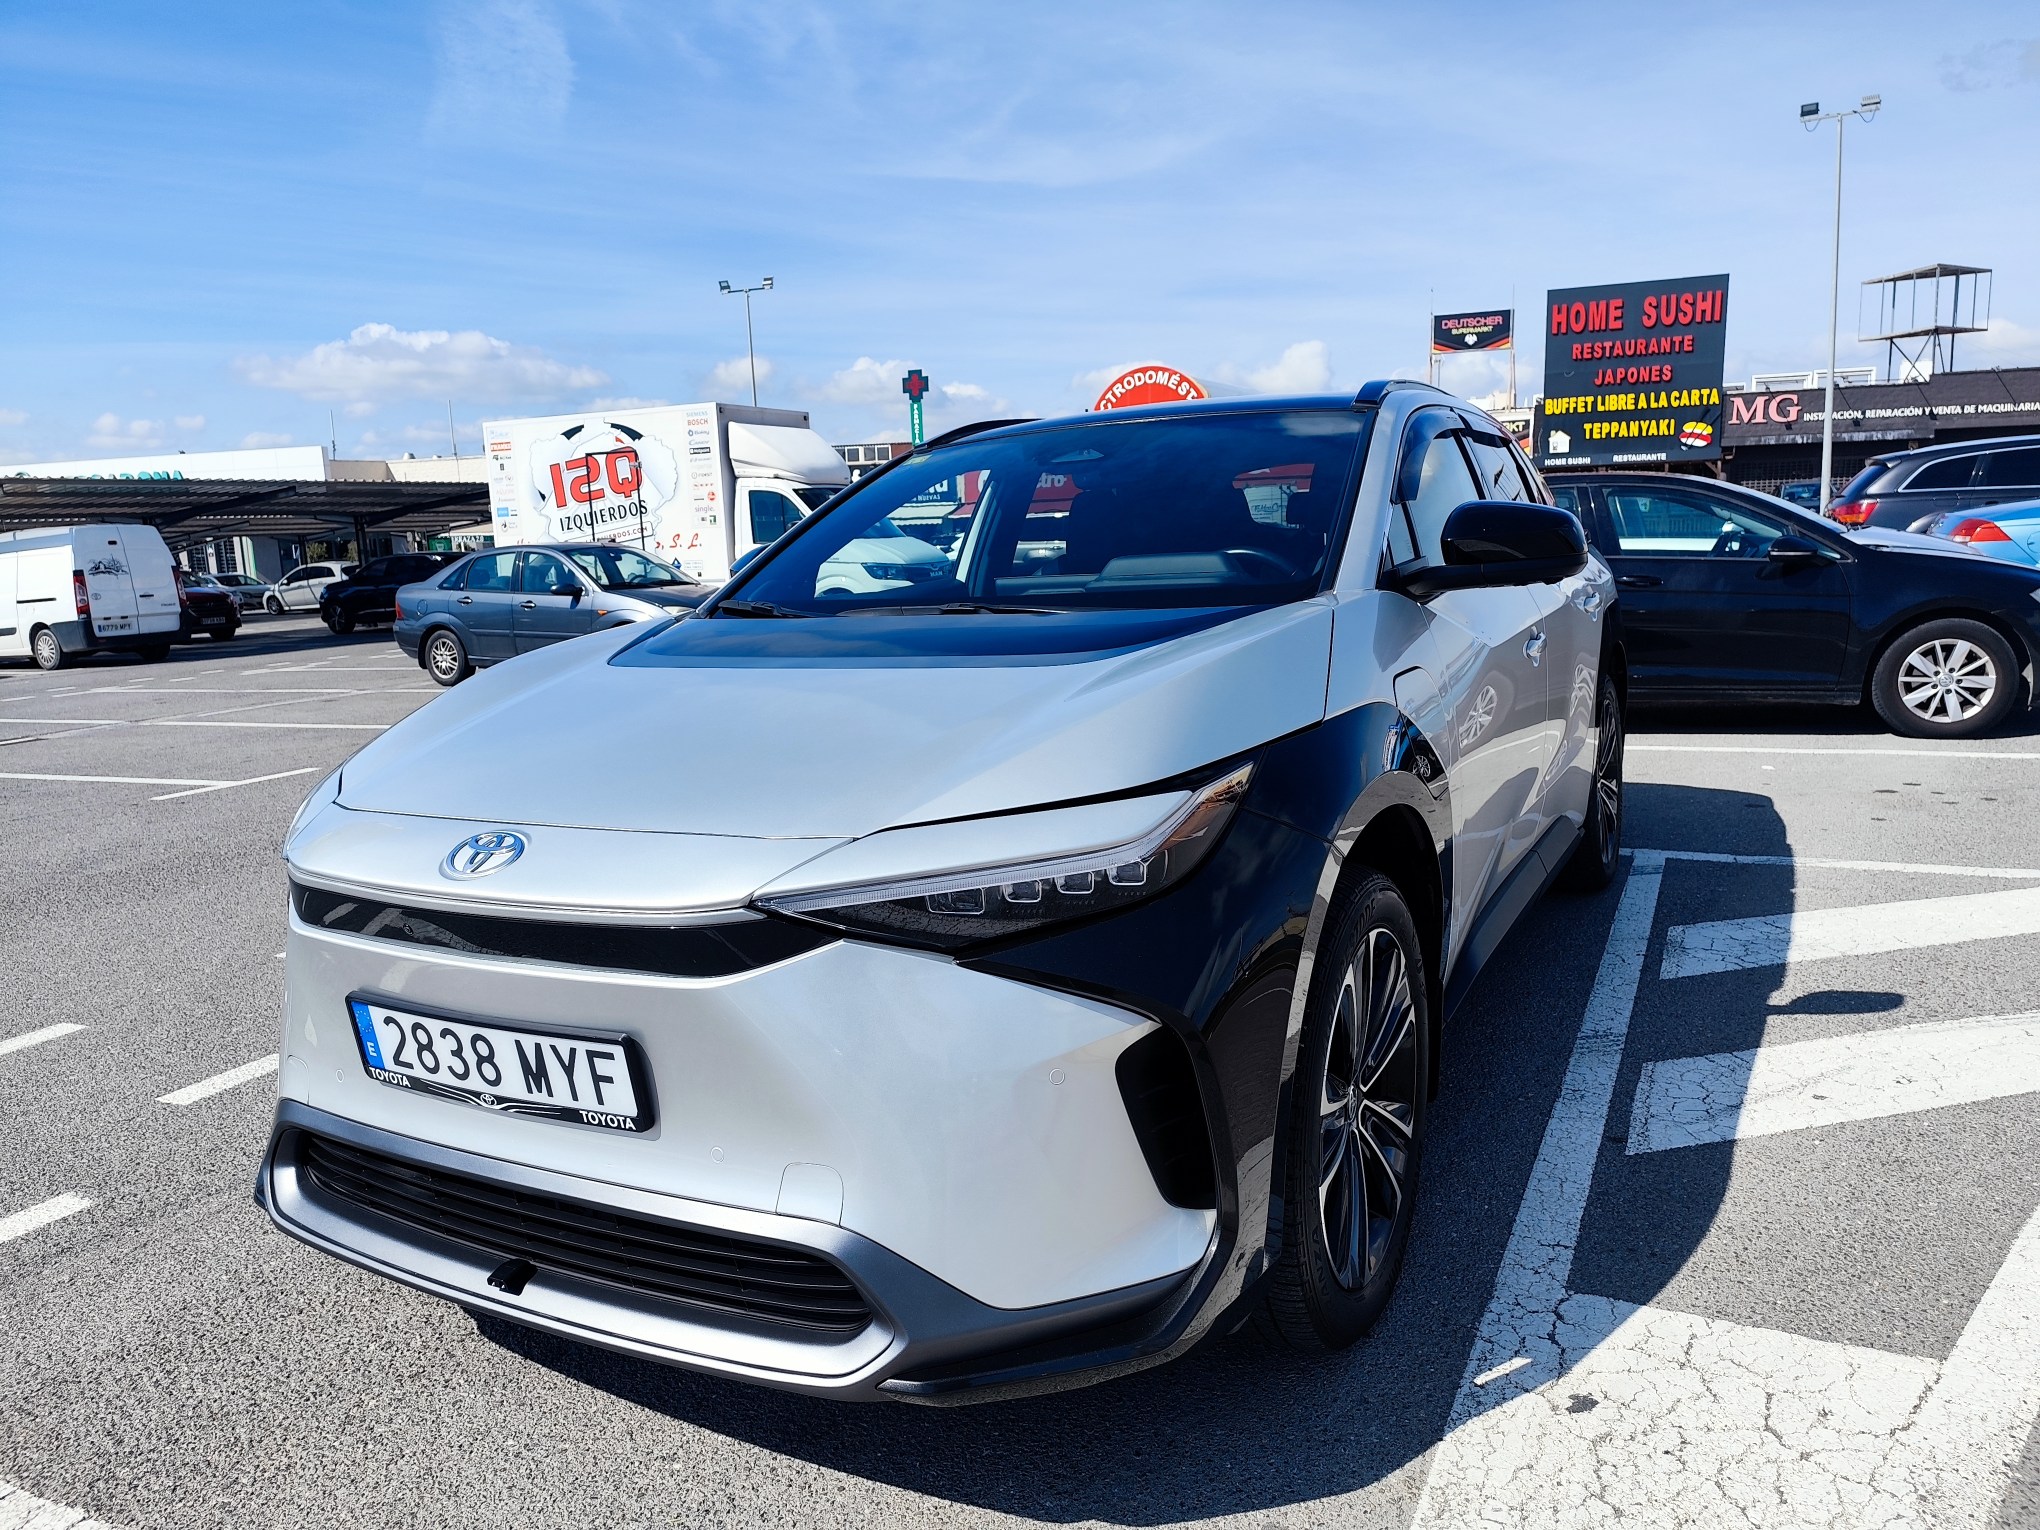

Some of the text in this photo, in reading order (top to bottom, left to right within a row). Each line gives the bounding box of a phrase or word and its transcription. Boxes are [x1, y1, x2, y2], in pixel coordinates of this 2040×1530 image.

[1441, 315, 1503, 330] DEUTSCHER
[1551, 290, 1723, 335] HOME SUSHI
[1572, 335, 1694, 360] RESTAURANTE
[1594, 366, 1672, 386] JAPONES
[1544, 388, 1720, 415] BUFFET LIBRE A LA CARTA
[1728, 393, 1802, 425] MG
[1866, 405, 1922, 419] REPARACIÓN
[1932, 405, 1962, 415] VENTA
[1963, 404, 1977, 414] DE
[687, 418, 709, 426] BOSCH
[913, 403, 921, 444] FARMACIA
[1583, 418, 1675, 440] TEPPANYAKI
[1544, 456, 1591, 466] HOME SUSHI
[1612, 452, 1667, 463] RESTAURANTE
[560, 500, 648, 532] IZQUIERDOS
[366, 1041, 377, 1057] E
[383, 1015, 616, 1106] 2838 MYF
[368, 1067, 411, 1088] TOYOTA
[579, 1110, 637, 1131] TOYOTA
